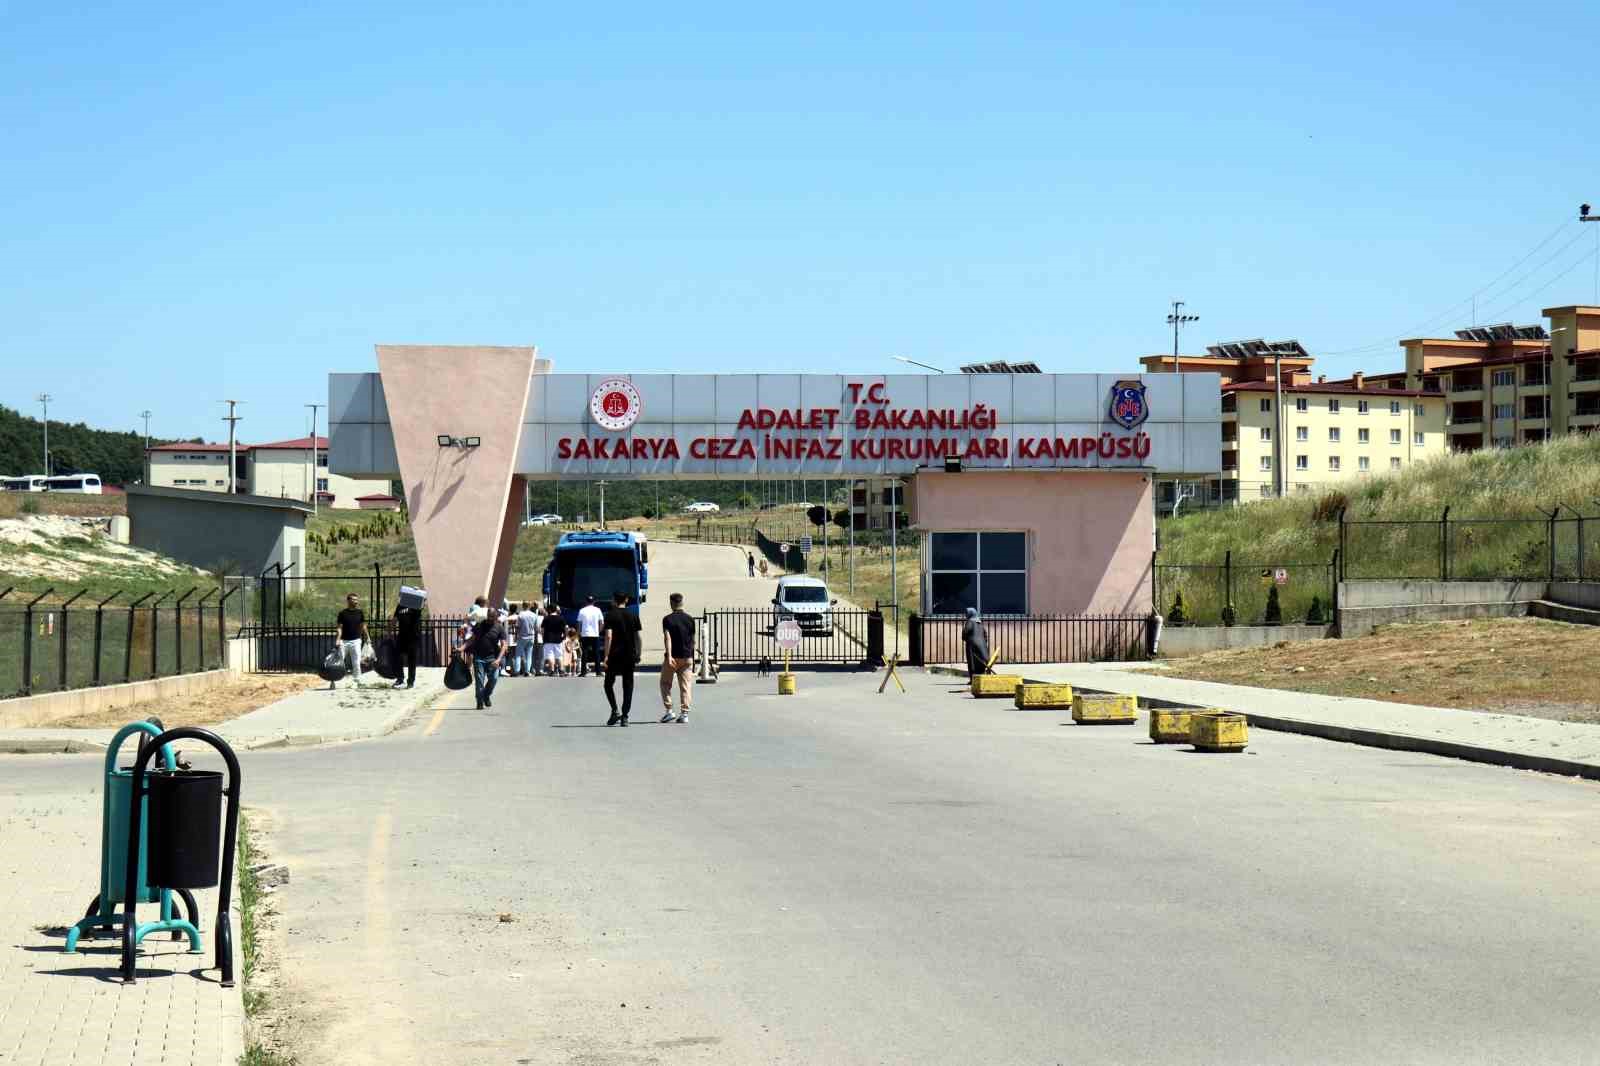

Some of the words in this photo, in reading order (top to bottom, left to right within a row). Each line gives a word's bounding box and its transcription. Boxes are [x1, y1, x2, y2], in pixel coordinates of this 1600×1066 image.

[848, 383, 890, 405] T.C.
[737, 408, 840, 430] ADALET
[855, 404, 997, 430] BAKANLIĞI
[558, 438, 680, 459] SAKARYA
[690, 438, 756, 459] CEZA
[764, 434, 842, 459] İNFAZ
[851, 438, 1008, 459] KURUMLARI
[1018, 432, 1151, 459] KAMPÜSÜ
